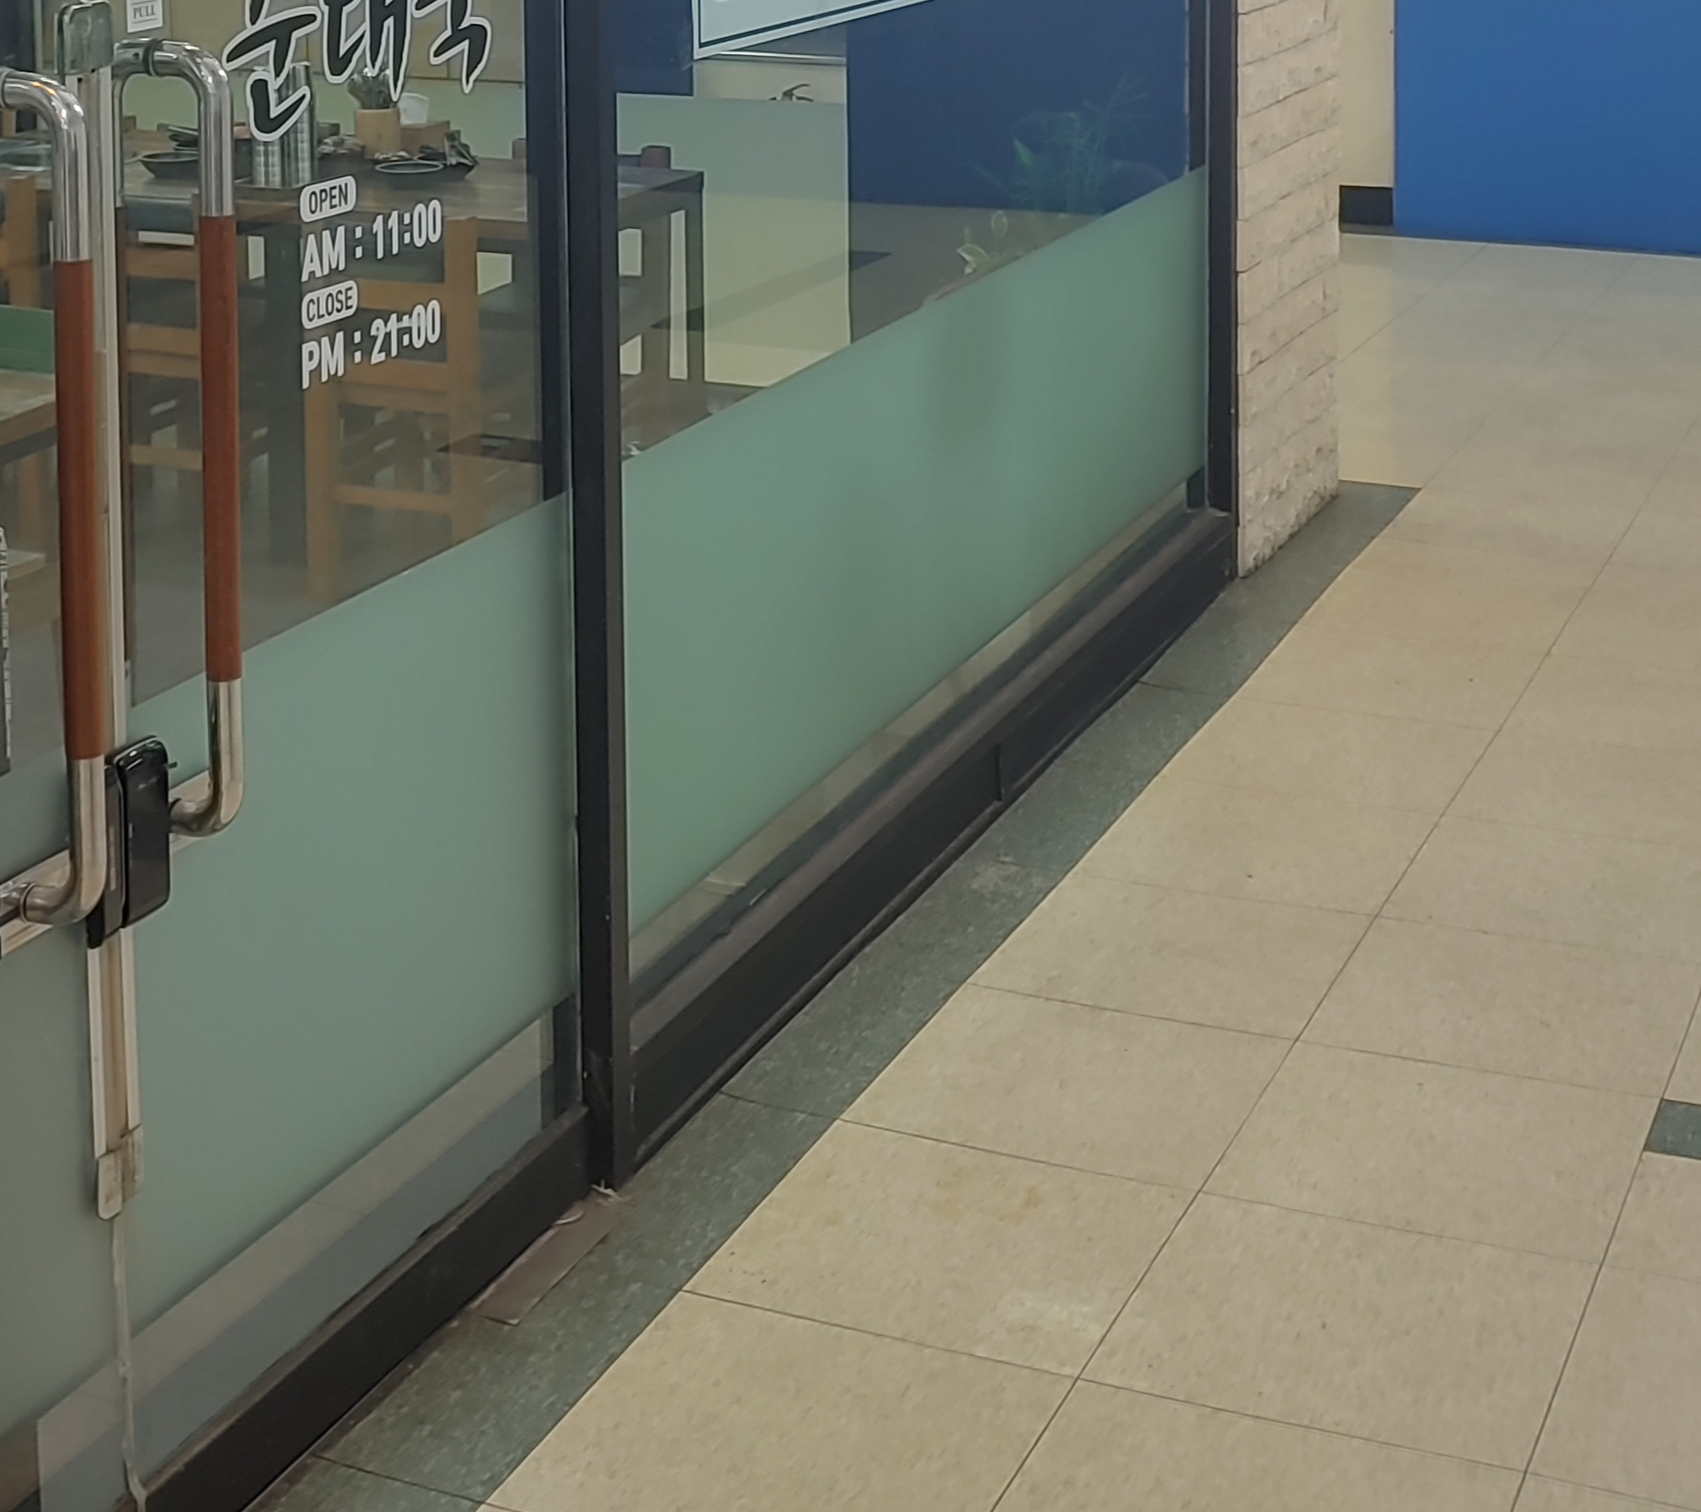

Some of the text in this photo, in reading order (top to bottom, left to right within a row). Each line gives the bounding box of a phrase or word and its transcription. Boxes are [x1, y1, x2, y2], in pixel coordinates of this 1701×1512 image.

[132, 4, 157, 20] PULL
[308, 182, 349, 215] OPEN
[301, 225, 346, 283] AM
[372, 199, 442, 260] 11:00
[306, 286, 354, 323] CLOSE
[301, 330, 345, 390] PM
[370, 299, 441, 365] 21:00
